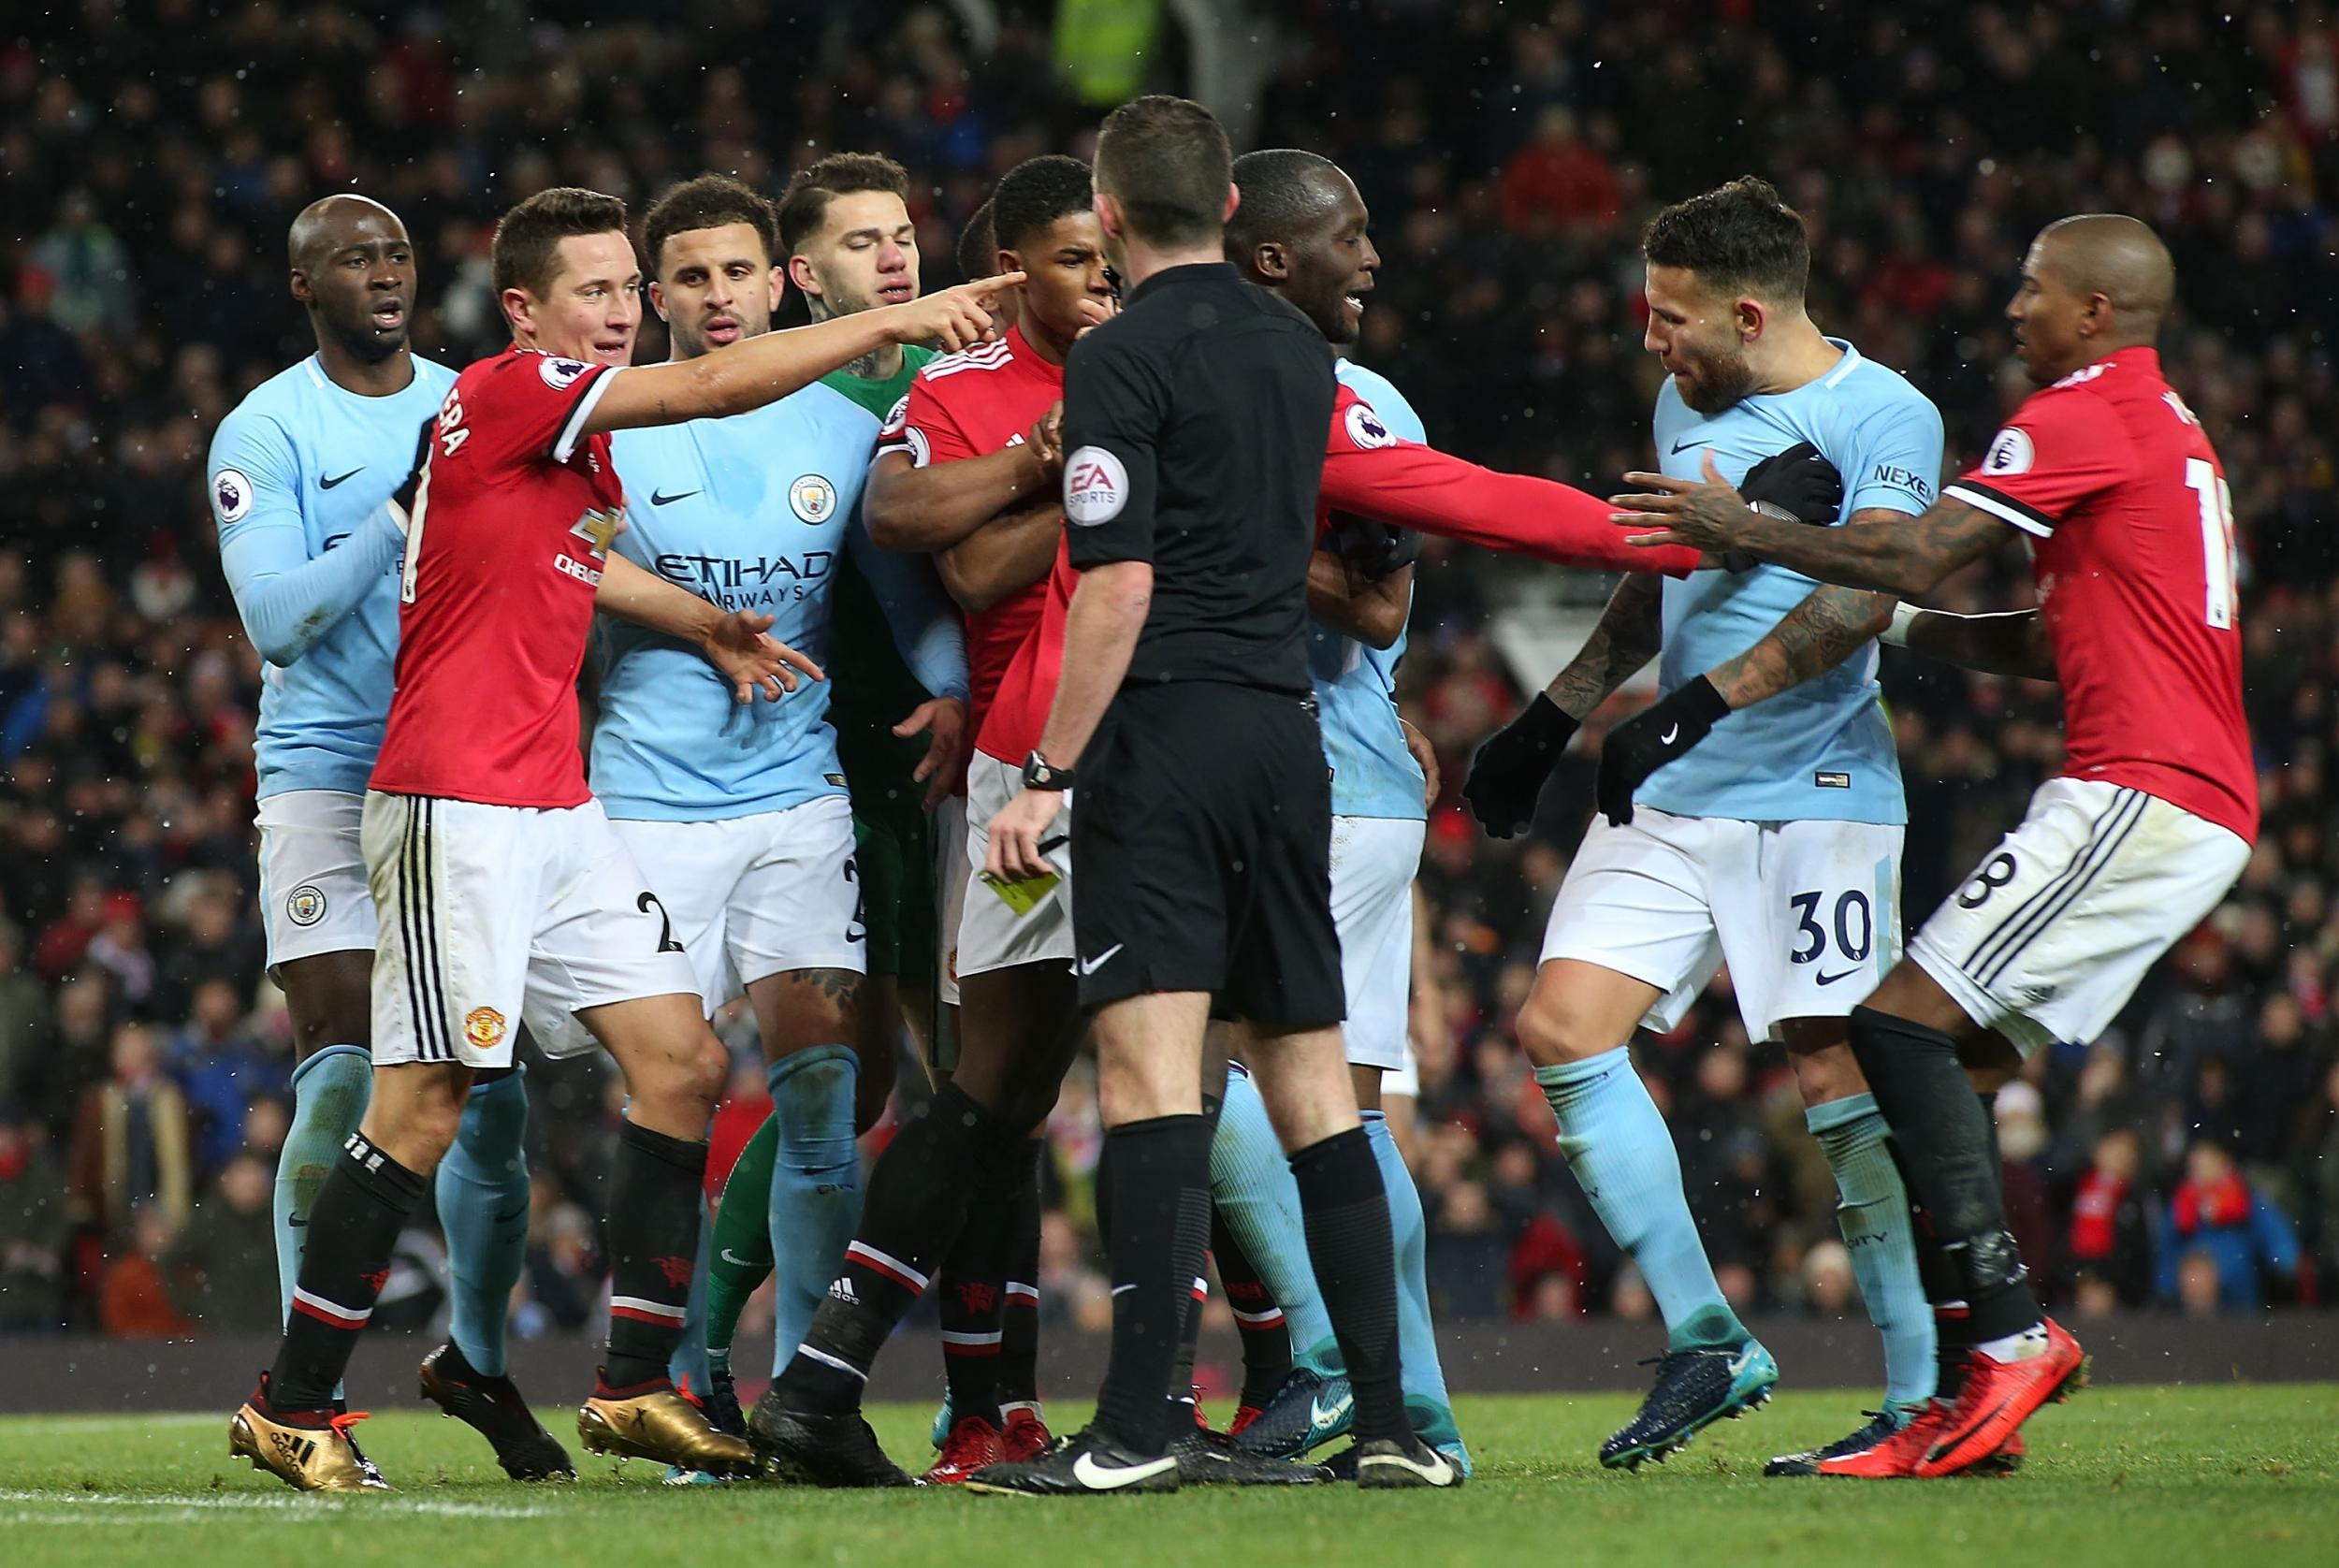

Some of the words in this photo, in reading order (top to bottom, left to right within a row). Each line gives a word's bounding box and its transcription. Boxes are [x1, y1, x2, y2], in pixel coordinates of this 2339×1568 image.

[1071, 463, 1114, 493] EA
[1069, 491, 1115, 507] SPORTS
[656, 551, 833, 587] ETIHAD
[637, 892, 685, 952] 2
[1790, 890, 1871, 965] 30
